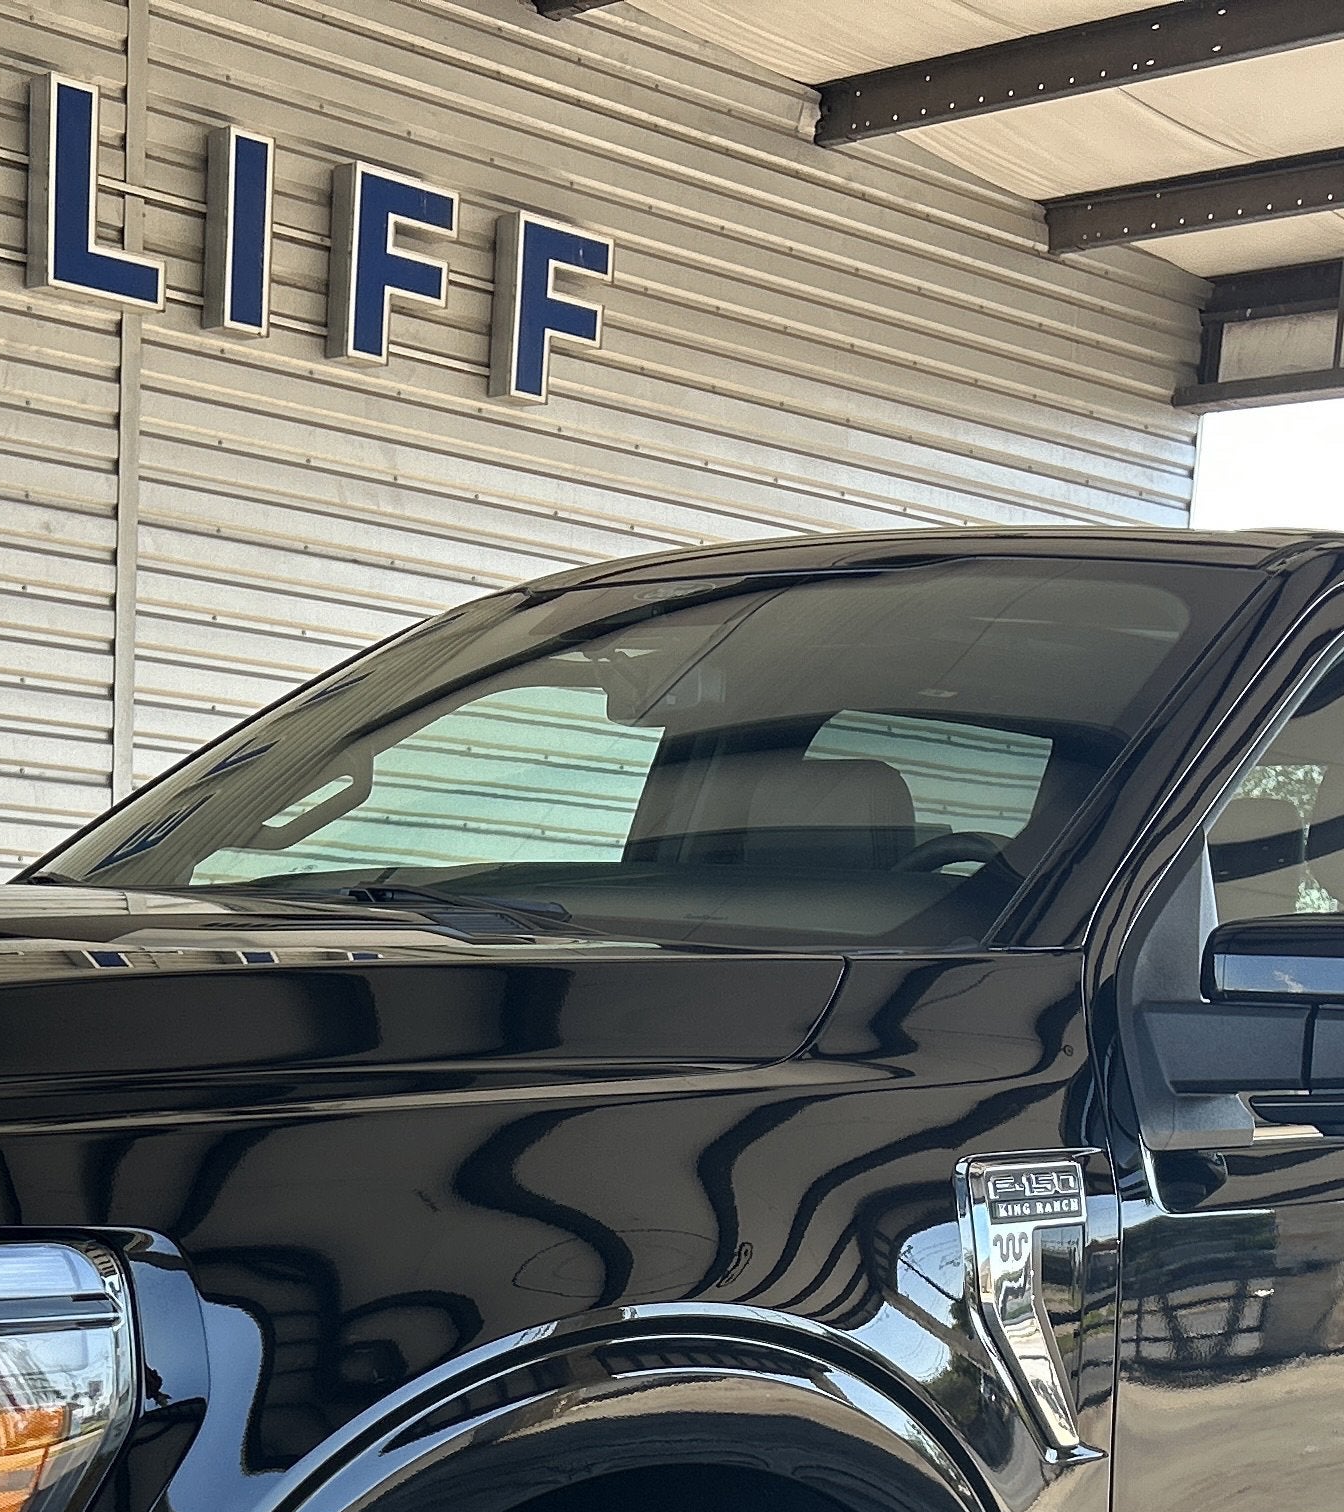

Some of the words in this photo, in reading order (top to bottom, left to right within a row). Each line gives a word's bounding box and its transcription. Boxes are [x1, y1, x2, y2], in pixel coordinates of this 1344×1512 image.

[988, 1172, 1079, 1199] F-150
[996, 1201, 1032, 1218] KING
[1035, 1197, 1080, 1215] RANCH
